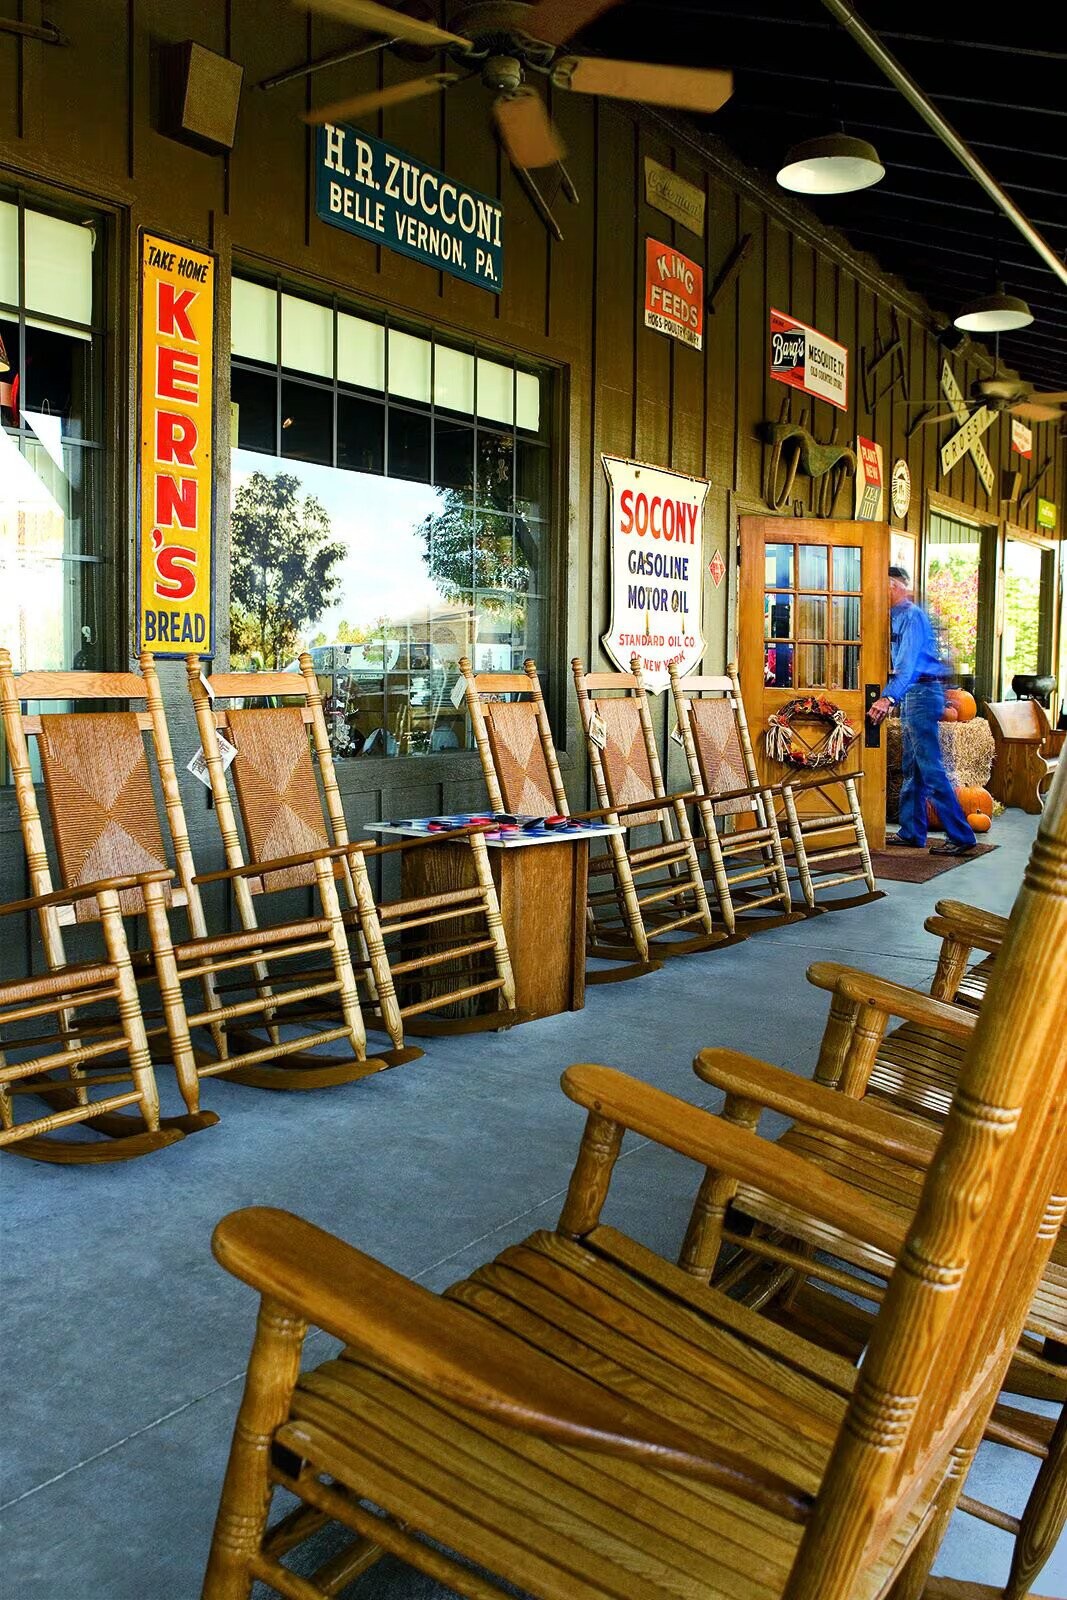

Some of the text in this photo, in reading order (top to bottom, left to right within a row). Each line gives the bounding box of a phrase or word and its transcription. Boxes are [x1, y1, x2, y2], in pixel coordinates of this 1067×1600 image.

[385, 153, 502, 248] ZUCCONI
[330, 181, 498, 282] BELLE VERNON, PA.
[149, 246, 209, 284] TAKE HOME
[656, 254, 695, 294] KING
[649, 284, 698, 328] FEEDS
[150, 279, 201, 602] KERN'S
[944, 410, 996, 467] CROSSIN
[620, 489, 698, 545] SOCONY
[628, 550, 689, 581] GASOLINE
[628, 585, 689, 613] MOTOR OIL
[145, 609, 206, 644] BREAD
[619, 633, 664, 647] STANDARD
[668, 635, 682, 647] OIL
[643, 659, 662, 672] NEW
[664, 651, 686, 669] YORK
